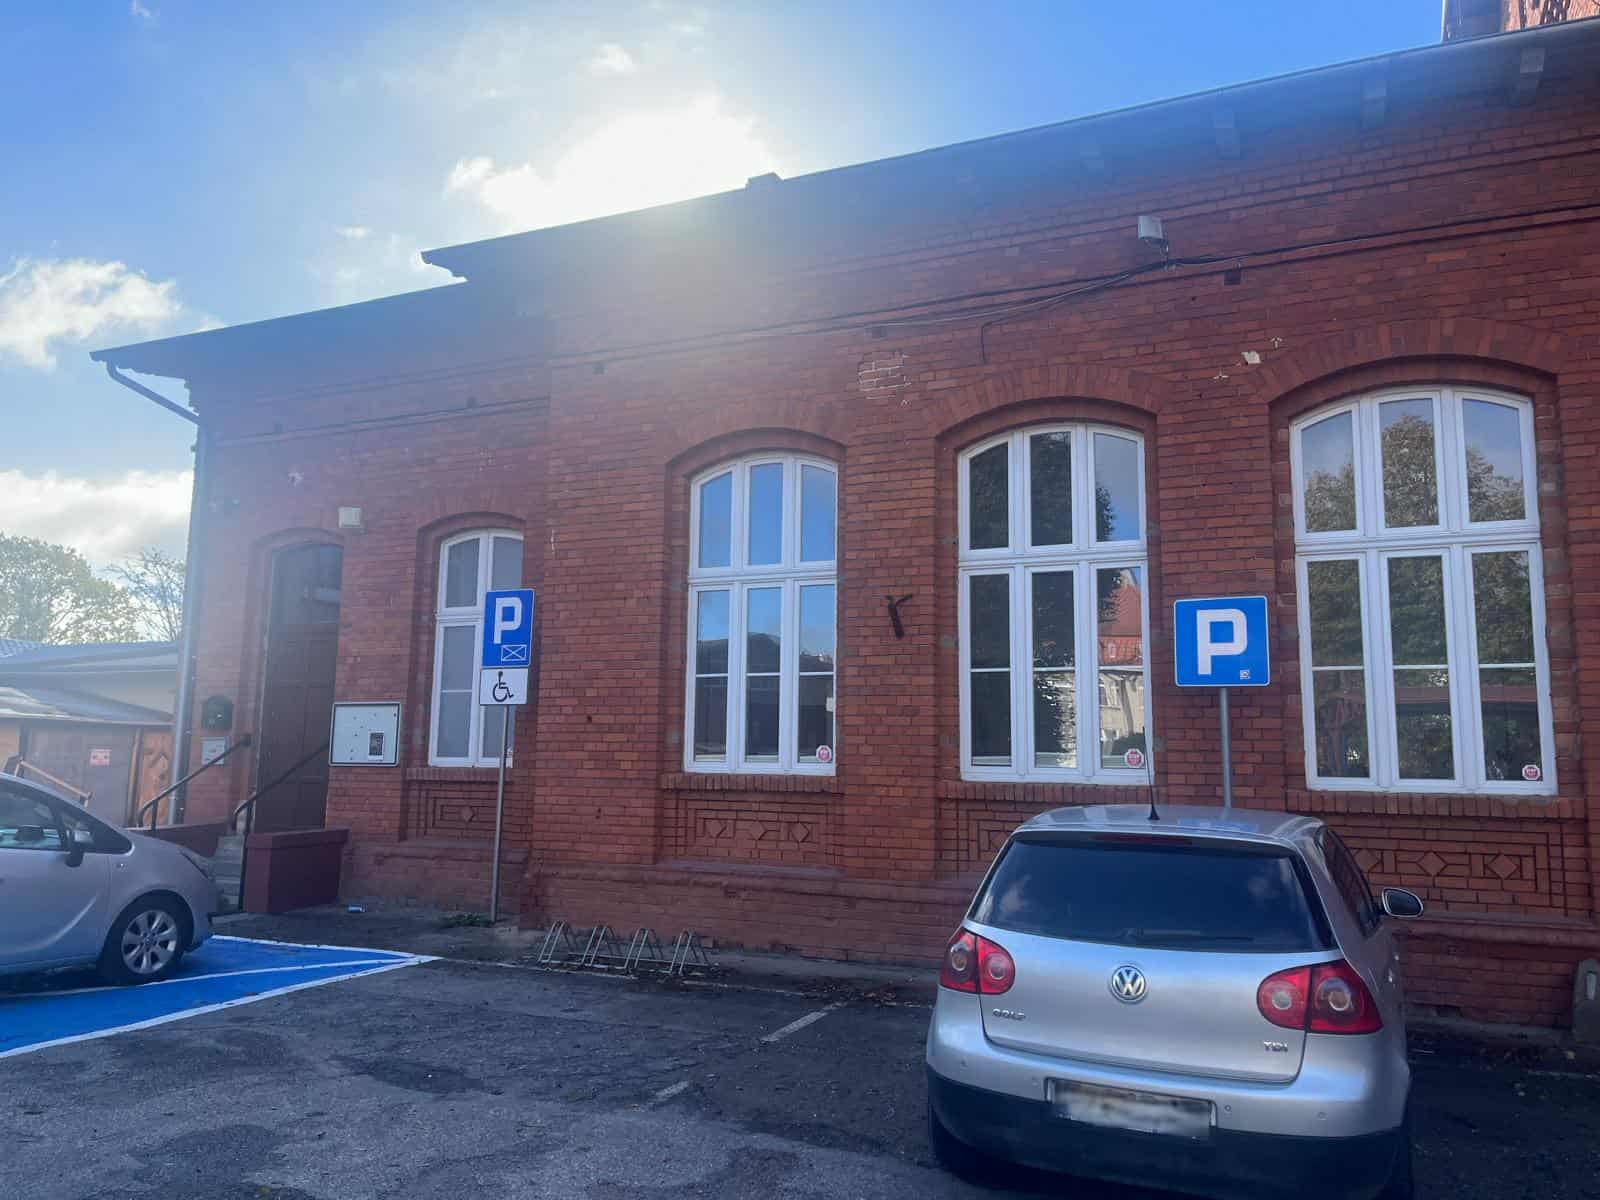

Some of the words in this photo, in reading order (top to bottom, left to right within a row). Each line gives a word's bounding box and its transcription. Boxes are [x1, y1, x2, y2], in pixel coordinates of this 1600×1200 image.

[494, 597, 522, 644] P
[1196, 608, 1248, 675] P
[1263, 1041, 1288, 1052] TDI
